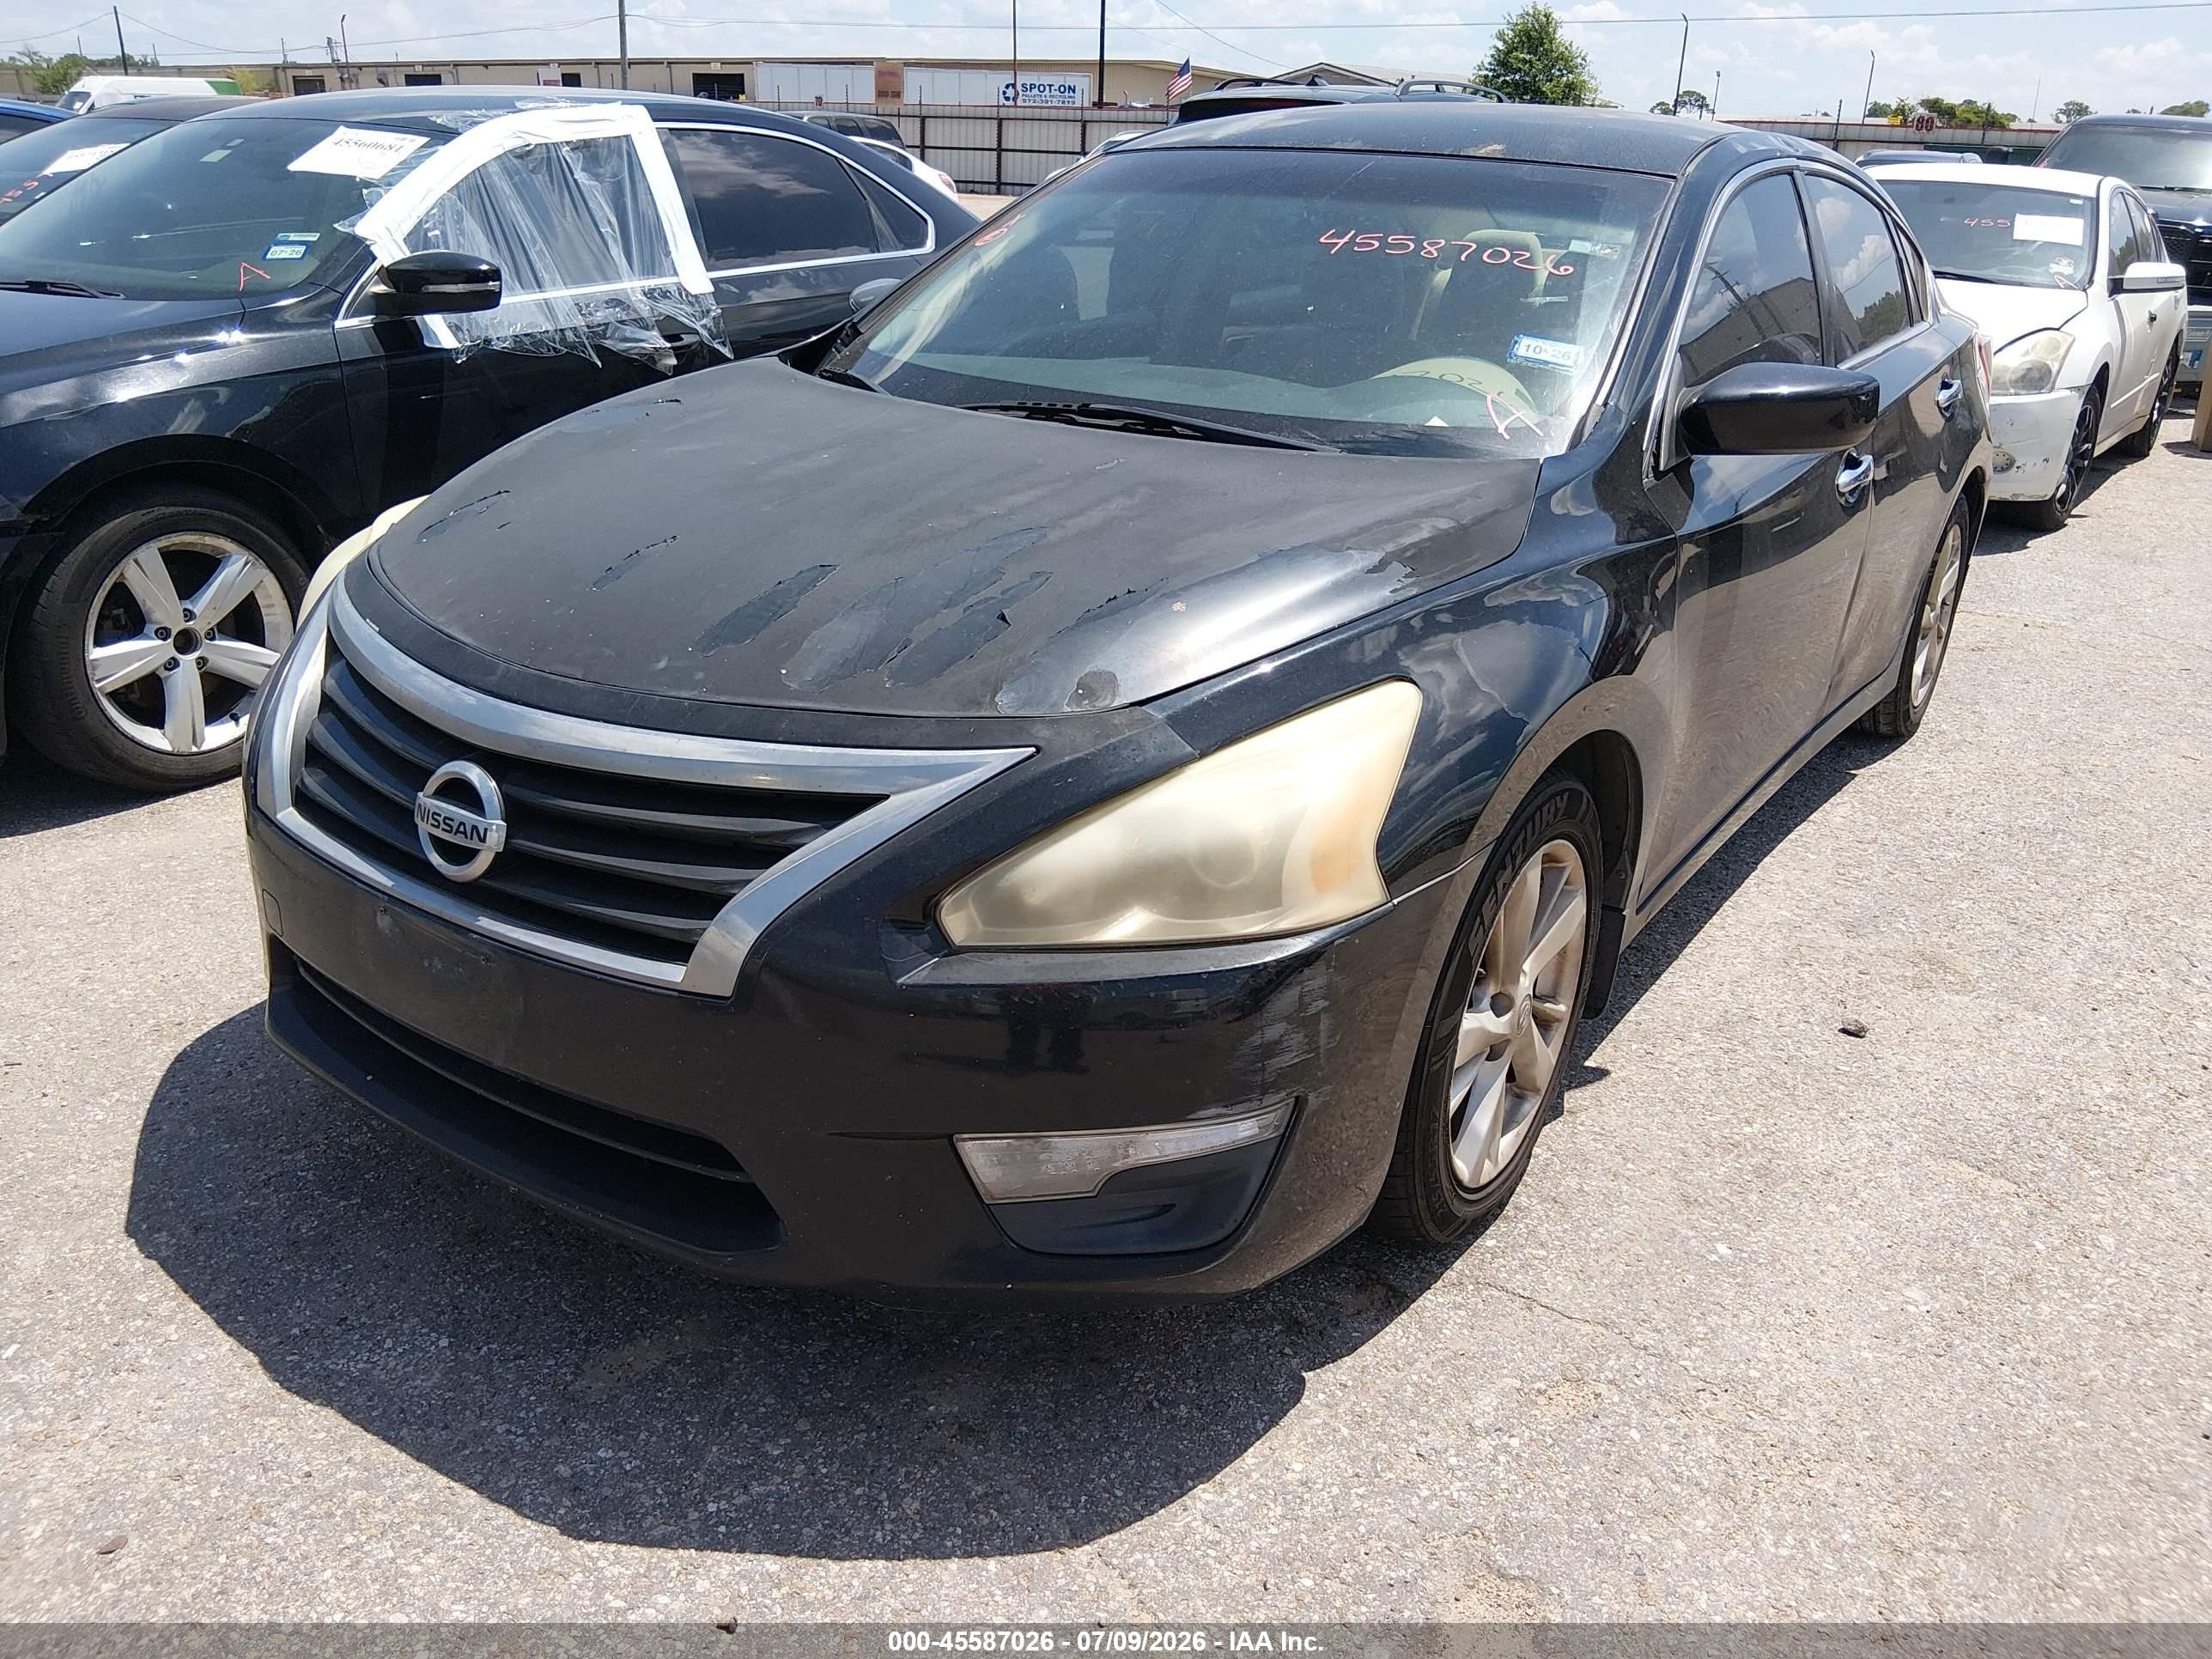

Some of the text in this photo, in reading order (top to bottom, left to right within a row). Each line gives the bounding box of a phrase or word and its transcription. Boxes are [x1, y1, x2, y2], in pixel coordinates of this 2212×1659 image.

[1021, 82, 1077, 94] SPOT-ON
[1915, 115, 1936, 131] 80
[1318, 228, 1575, 276] 45587026
[1524, 343, 1572, 361] 10 26
[1486, 393, 1545, 440] A
[416, 802, 489, 844] NISSAN
